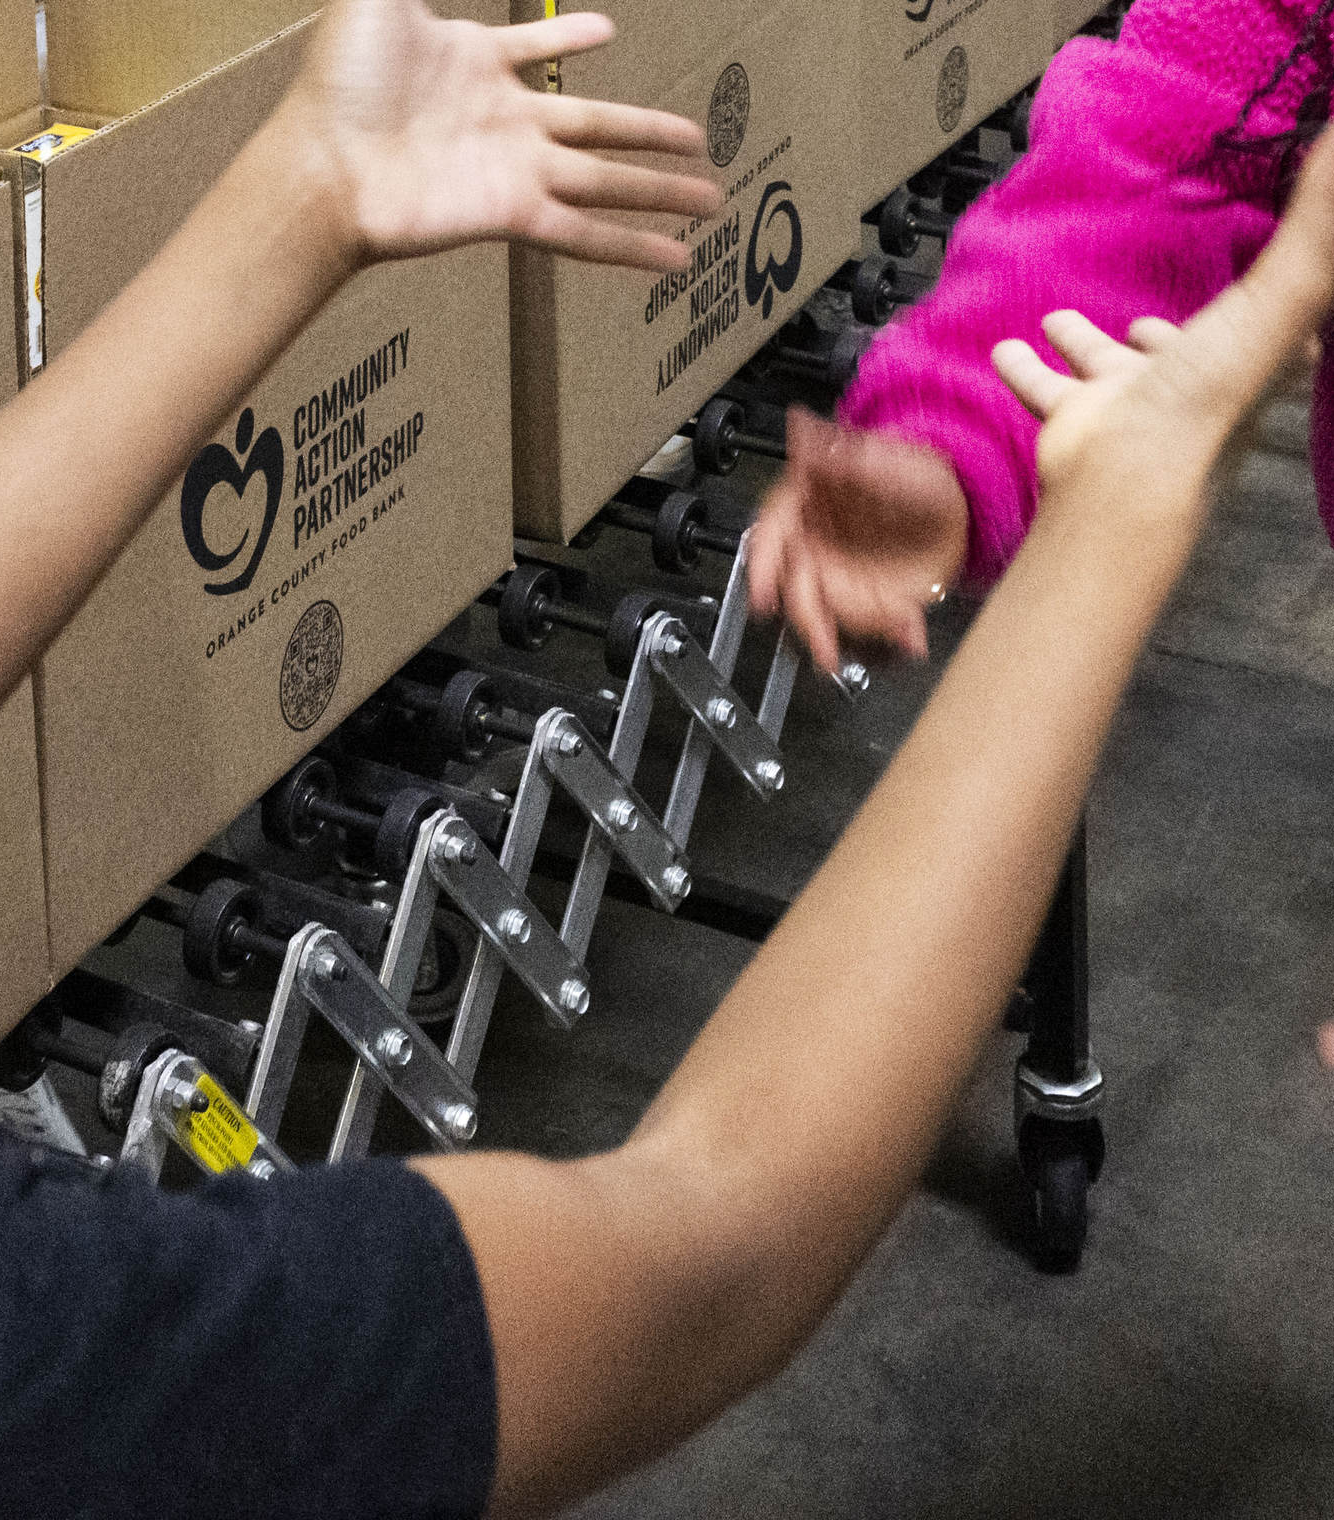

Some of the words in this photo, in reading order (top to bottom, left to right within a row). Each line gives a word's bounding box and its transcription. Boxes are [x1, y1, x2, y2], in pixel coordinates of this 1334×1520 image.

[725, 169, 754, 204] COUNT
[757, 136, 792, 176] ORANGE
[690, 250, 740, 325] ACTION
[655, 287, 740, 397] COMMUNITY
[294, 328, 411, 451] COMMUNITY
[294, 410, 365, 499] ACTION
[294, 411, 424, 550] PARTNERSHIP
[205, 600, 266, 659] ORANGE
[271, 549, 327, 605] COUNTY
[331, 517, 366, 556] FOOD
[372, 485, 406, 521] BANK
[212, 1097, 243, 1133] CAUTION
